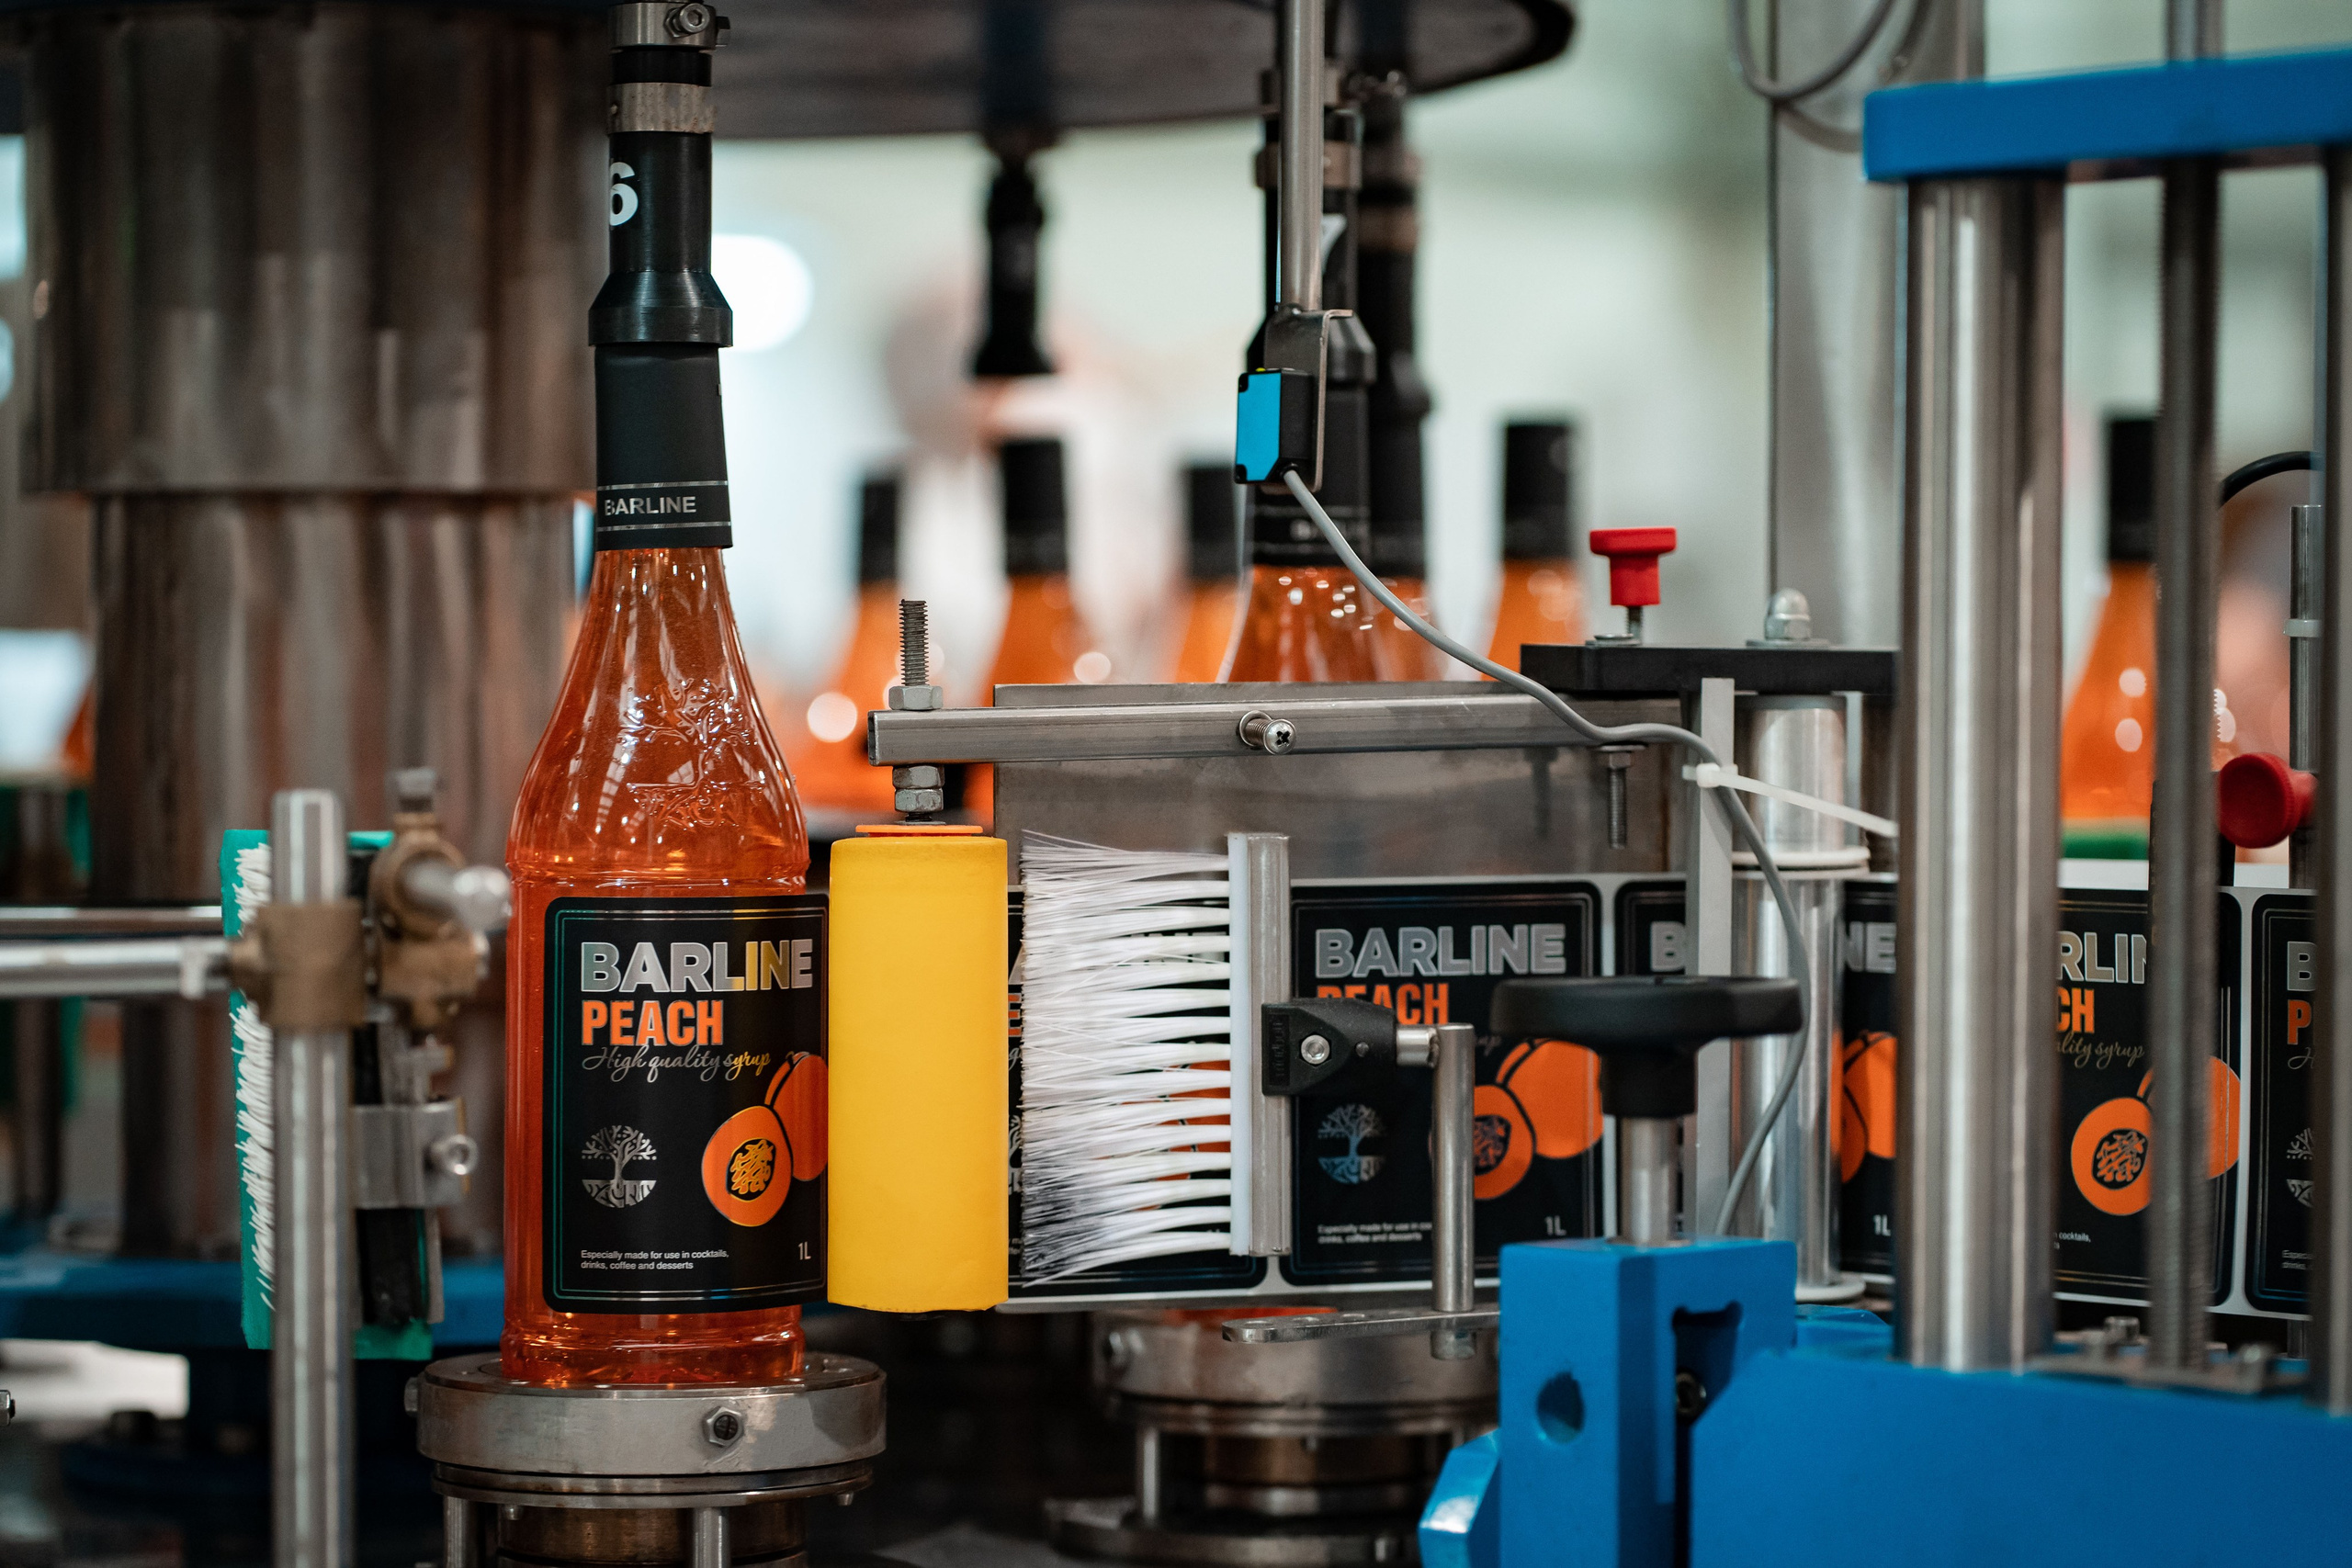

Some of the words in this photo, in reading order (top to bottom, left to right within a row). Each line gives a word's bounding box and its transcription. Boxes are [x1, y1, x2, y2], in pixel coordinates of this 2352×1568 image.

[609, 161, 639, 227] 6
[605, 496, 697, 516] BARLINE
[1315, 923, 1566, 979] BARLINE
[581, 938, 814, 993] BARLINE
[1317, 982, 1449, 1025] ACH
[581, 999, 724, 1047] PEACH
[582, 1044, 650, 1083] High
[646, 1043, 721, 1084] quality
[722, 1051, 772, 1082] syrup
[2095, 1041, 2145, 1070] syrup
[1544, 1214, 1567, 1236] 1L
[1873, 1213, 1892, 1237] 1L
[2058, 1232, 2092, 1243] cocktails,
[580, 1249, 624, 1261] Especially
[624, 1250, 649, 1259] made
[650, 1250, 662, 1259] for
[663, 1251, 681, 1259] use
[681, 1250, 690, 1259] in
[691, 1249, 729, 1258] cocktails,
[797, 1241, 812, 1260] 1L
[580, 1260, 608, 1270] drinks,
[609, 1261, 637, 1270] coffee
[638, 1261, 655, 1270] and
[656, 1261, 694, 1269] desserts
